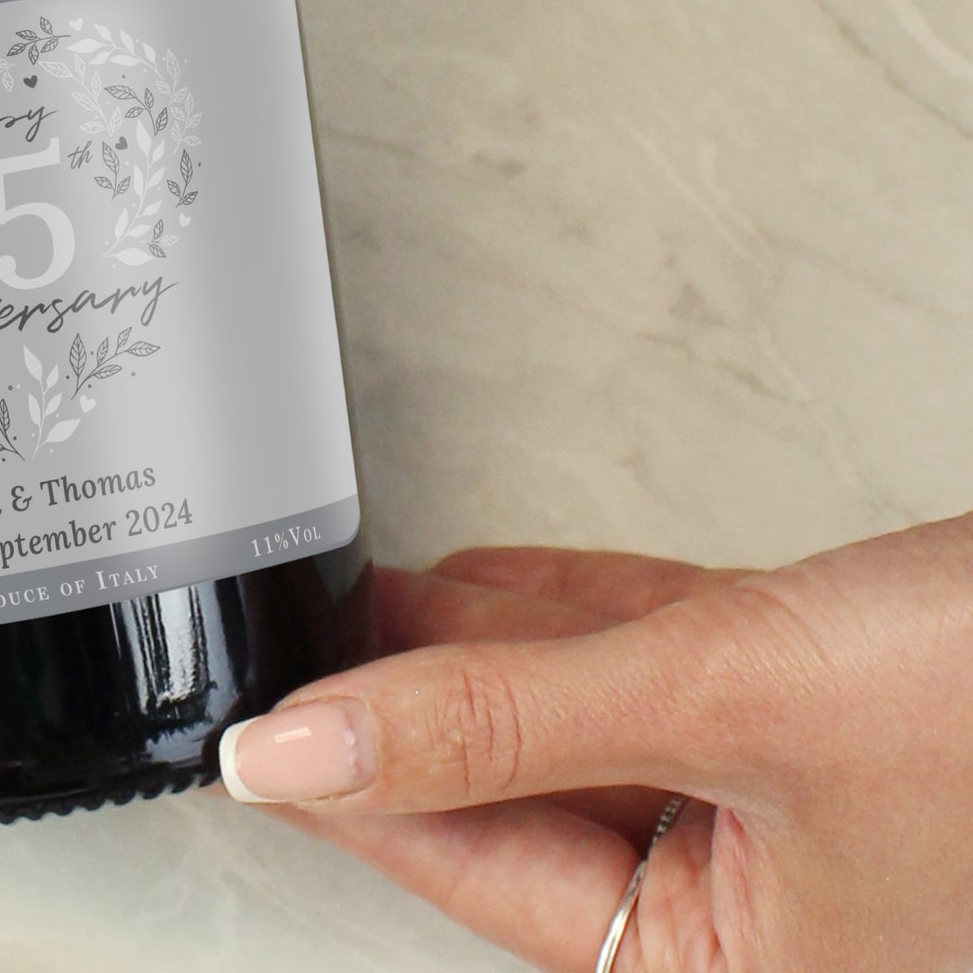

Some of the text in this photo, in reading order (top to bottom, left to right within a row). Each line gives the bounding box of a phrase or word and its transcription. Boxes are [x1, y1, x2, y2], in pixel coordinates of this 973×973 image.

[10, 485, 33, 512] &
[39, 467, 157, 507] Thomas
[125, 498, 193, 537] 2024
